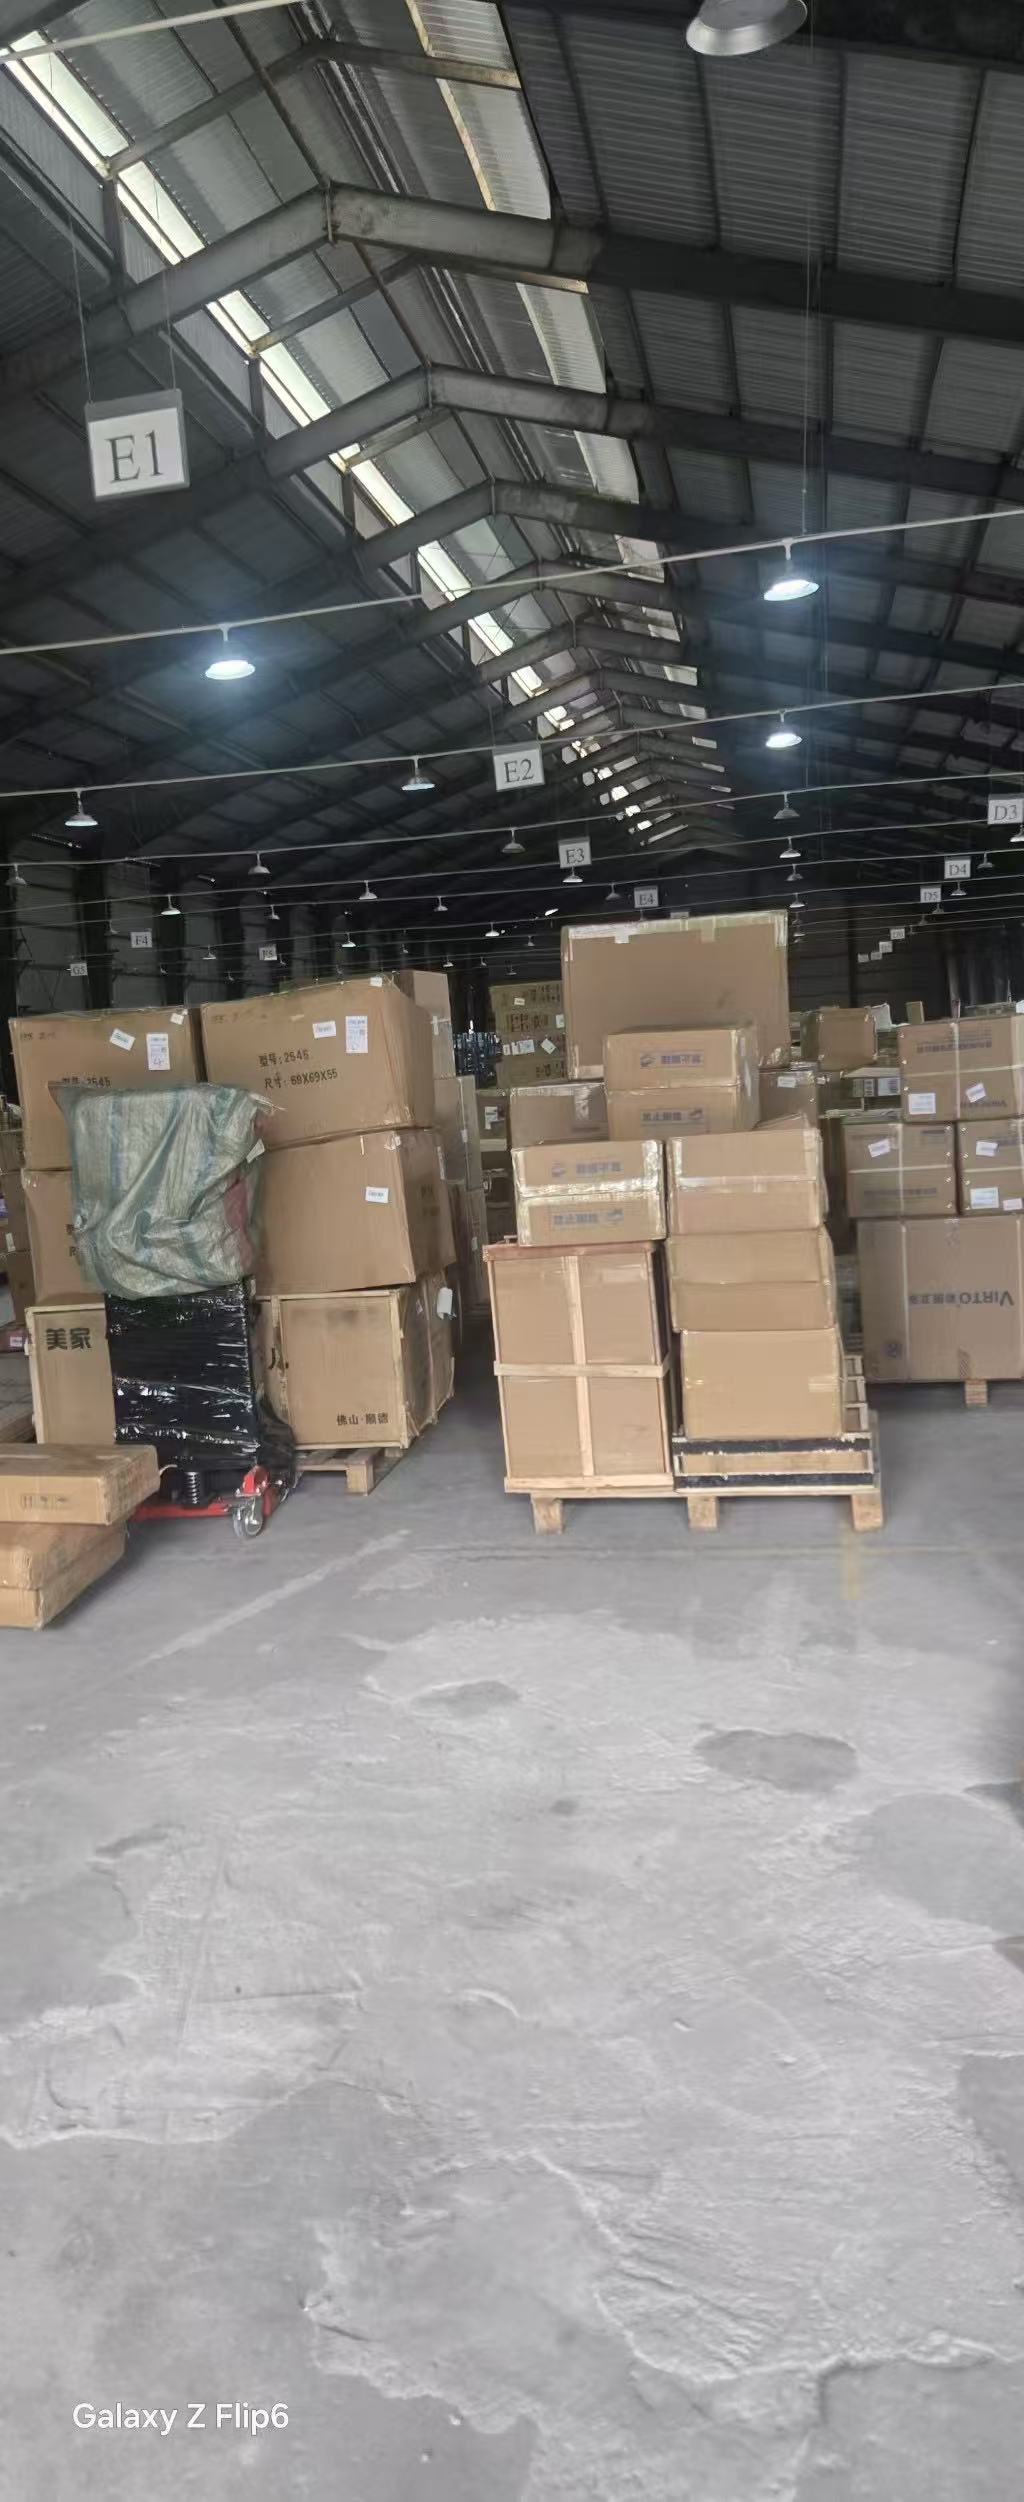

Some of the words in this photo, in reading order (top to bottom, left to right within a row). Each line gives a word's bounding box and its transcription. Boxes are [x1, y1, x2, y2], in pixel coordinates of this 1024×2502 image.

[104, 430, 164, 484] E1
[504, 758, 534, 783] E2
[994, 804, 1018, 821] D3
[566, 847, 585, 864] E3
[949, 863, 967, 877] D4
[640, 893, 654, 906] E4
[924, 891, 938, 901] D5
